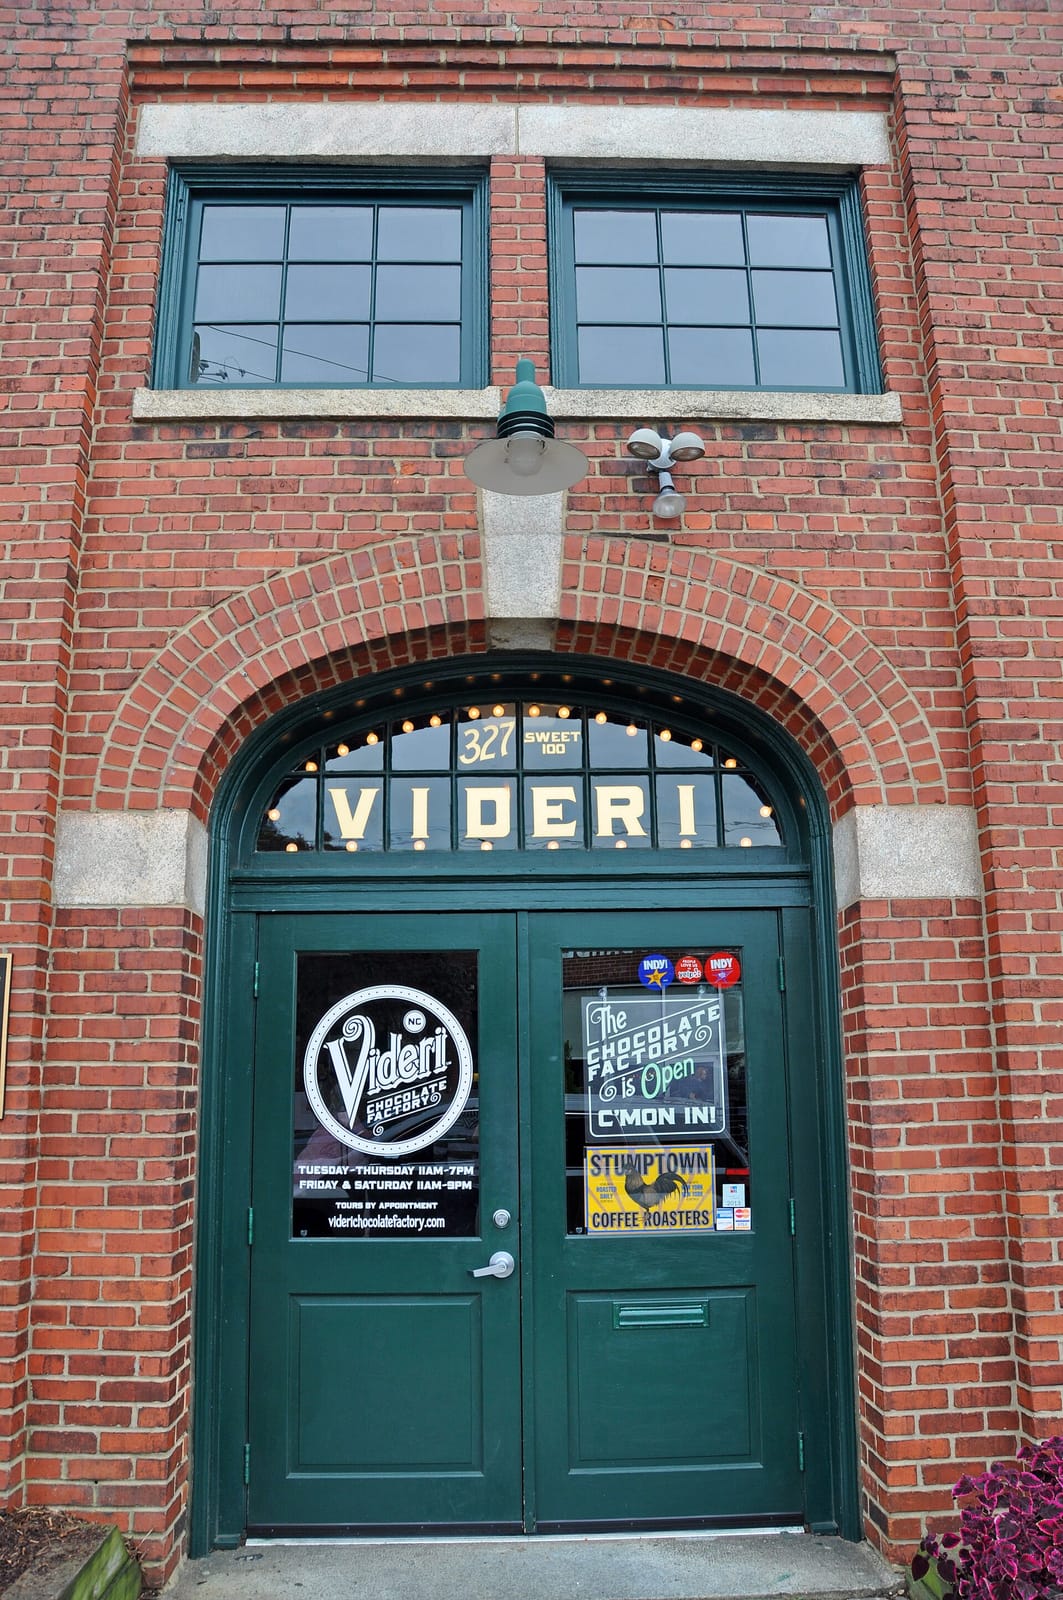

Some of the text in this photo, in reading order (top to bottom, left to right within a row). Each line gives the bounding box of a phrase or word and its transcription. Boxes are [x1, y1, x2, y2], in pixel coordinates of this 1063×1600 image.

[459, 720, 515, 764] 327
[524, 731, 581, 743] SWEET
[542, 744, 566, 755] 100
[328, 785, 696, 839] VIDERI
[710, 958, 733, 969] INDY
[408, 1017, 422, 1026] NC
[590, 1005, 627, 1042] The
[587, 1004, 721, 1066] CHOCOLATE
[588, 1030, 693, 1082] FACTORY
[323, 1015, 452, 1130] Videri
[621, 1057, 695, 1100] is Open
[366, 1079, 448, 1114] CHOCOLATE
[367, 1098, 430, 1124] FACTORY
[598, 1106, 716, 1128] C'MON IN!
[298, 1165, 415, 1175] TUESDAY-THURSDAY
[590, 1151, 709, 1177] STUMPTOWN
[299, 1180, 339, 1190] FRIDAY
[342, 1180, 351, 1190] &
[354, 1180, 414, 1190] SATURDAY
[328, 1214, 445, 1231] viderichocolatefactory.com
[592, 1211, 640, 1228] COFFEE
[643, 1210, 709, 1227] ROASTERS
